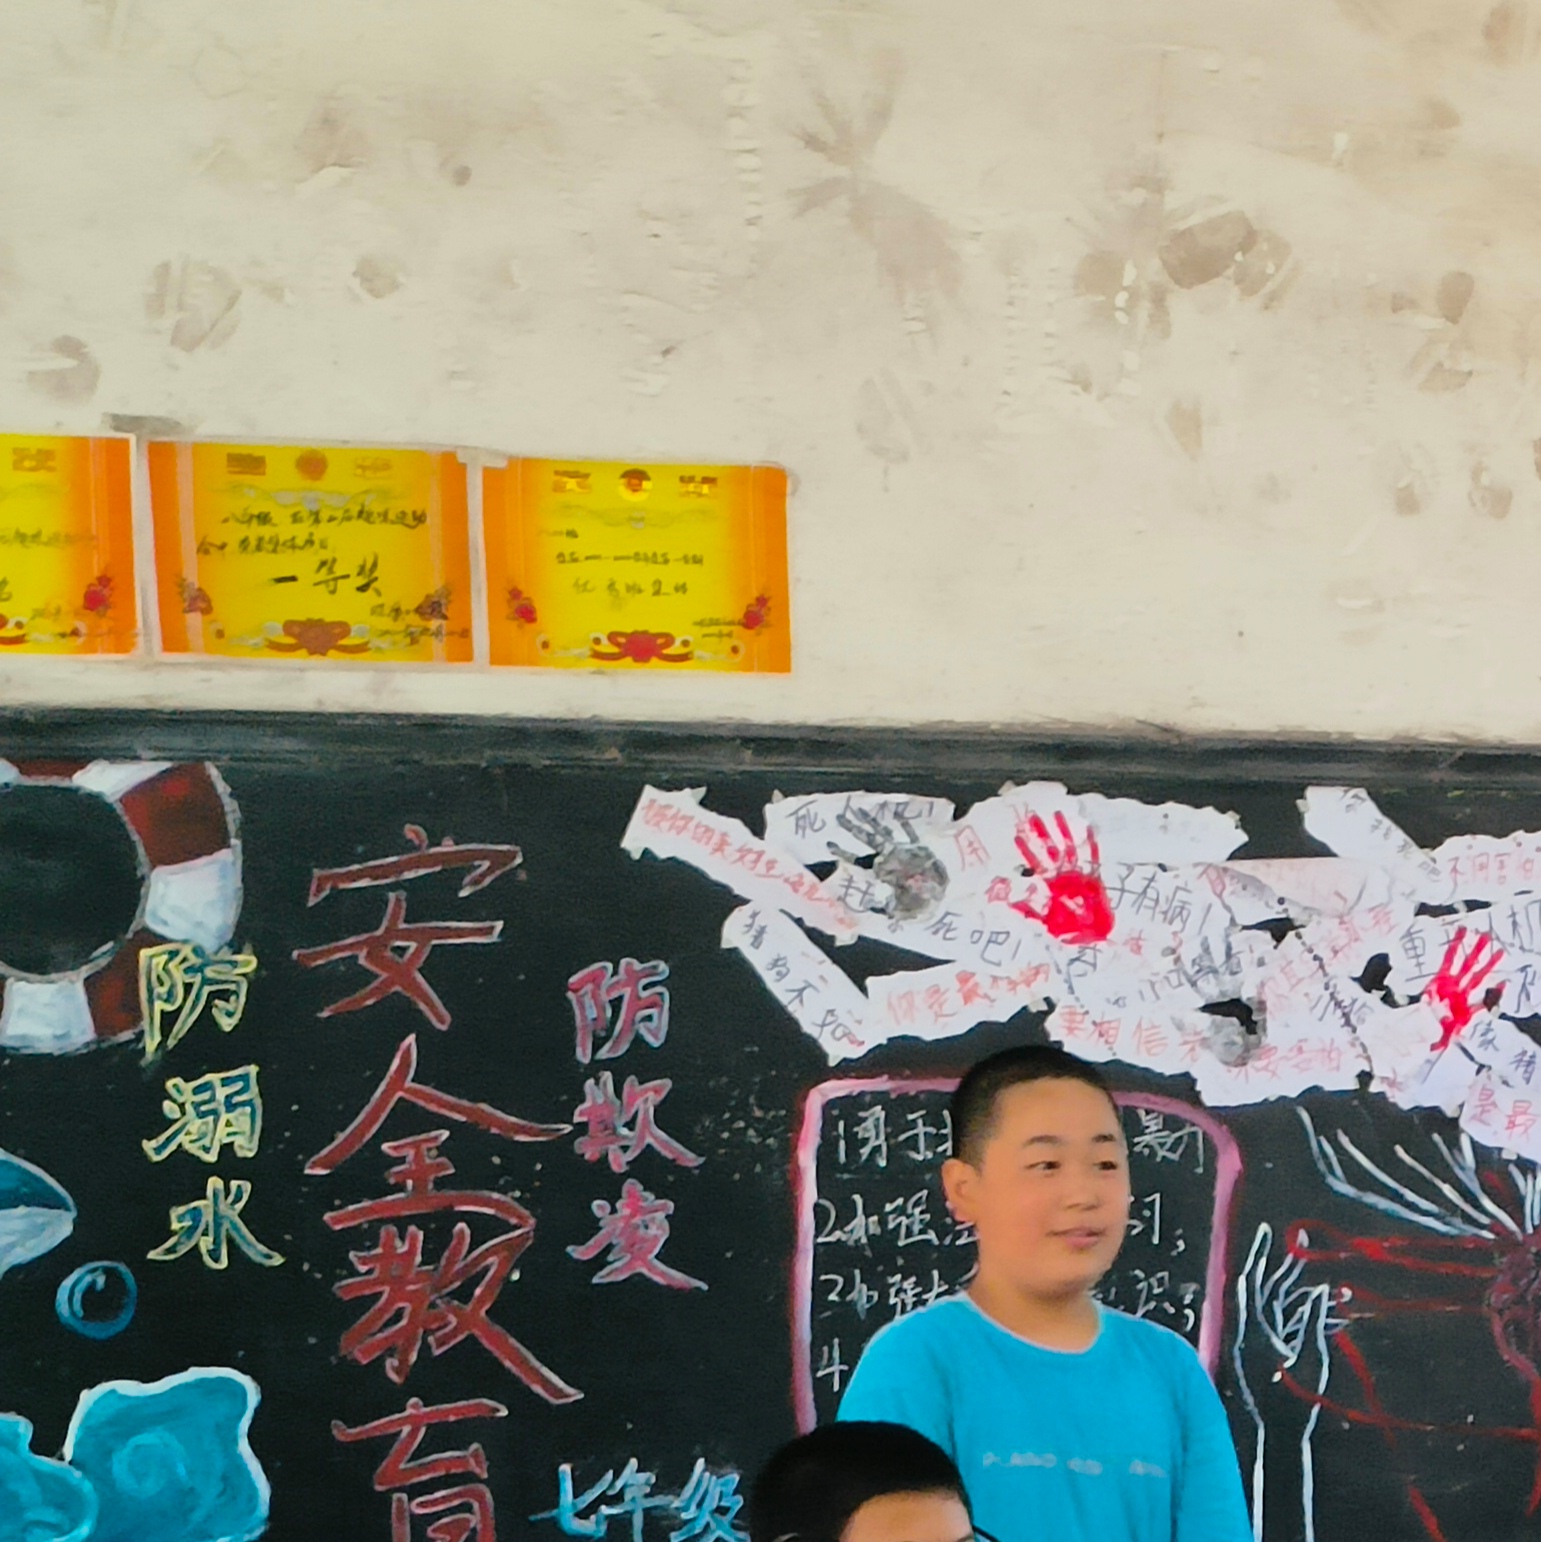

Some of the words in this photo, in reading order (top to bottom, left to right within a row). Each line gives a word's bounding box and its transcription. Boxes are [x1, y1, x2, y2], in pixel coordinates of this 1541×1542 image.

[138, 943, 286, 1270] 防溺水
[566, 956, 709, 1291] 防欺凌
